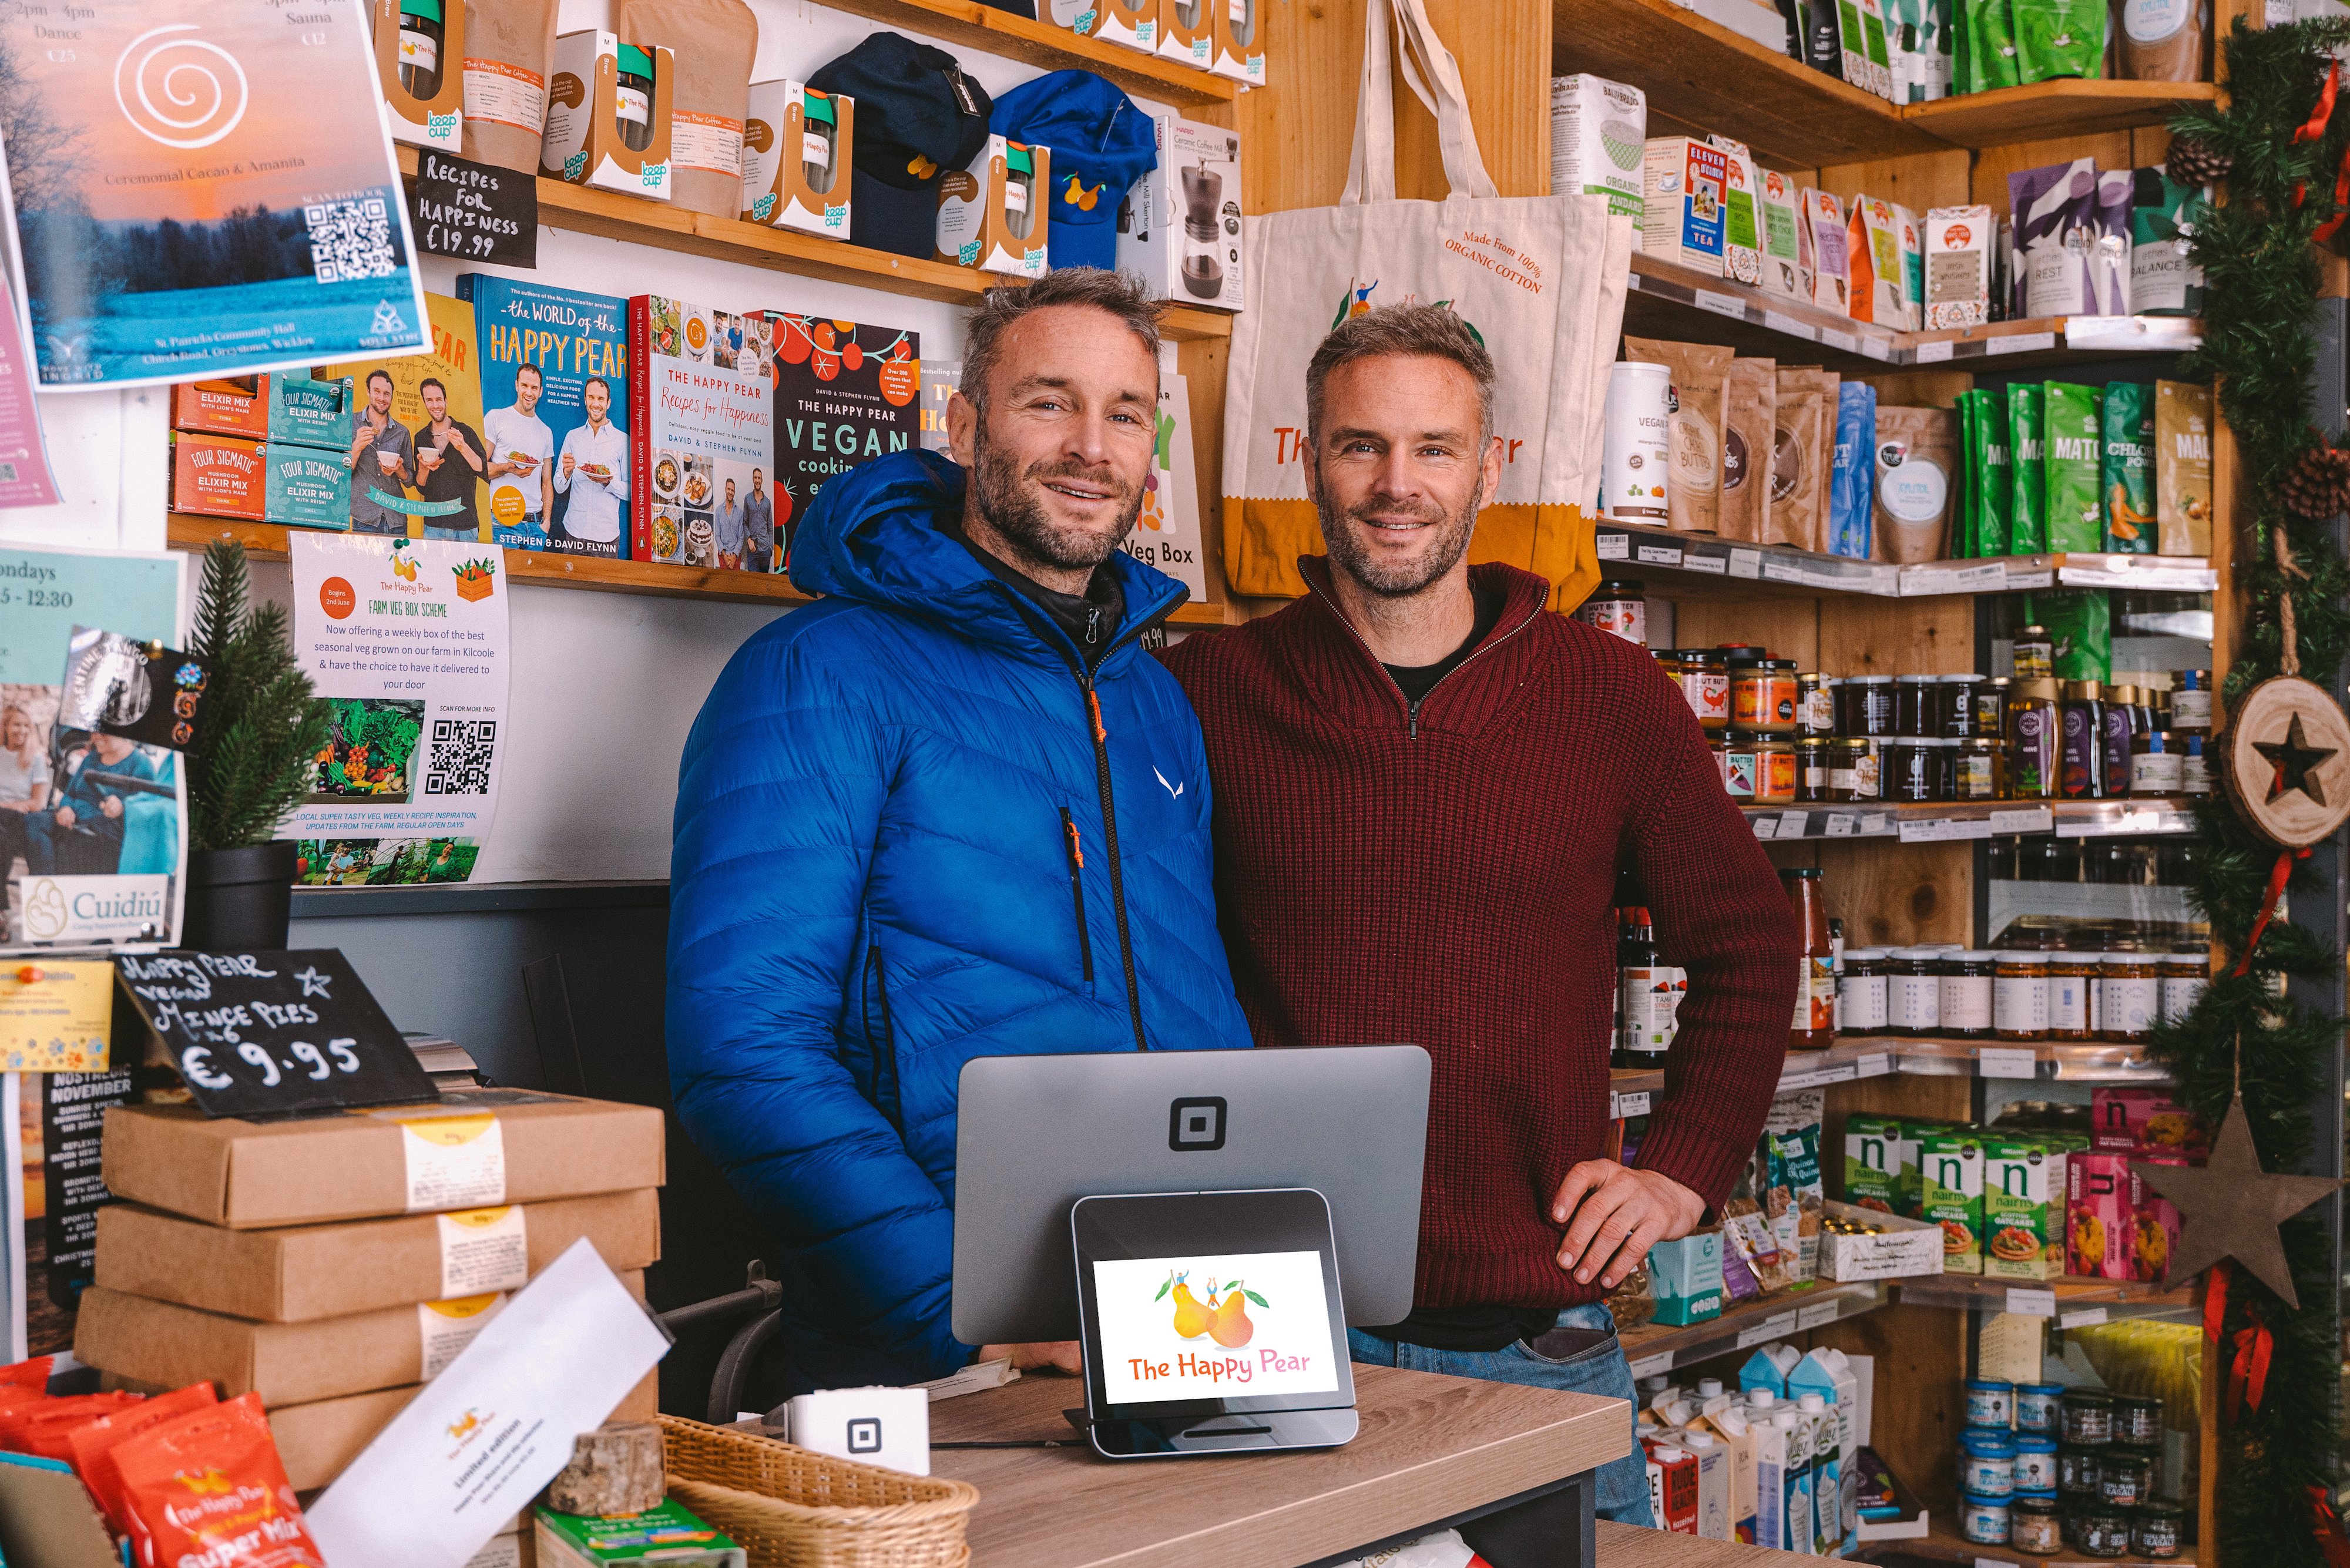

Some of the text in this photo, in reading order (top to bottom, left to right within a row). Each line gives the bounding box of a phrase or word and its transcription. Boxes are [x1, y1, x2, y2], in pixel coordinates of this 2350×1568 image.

[287, 13, 332, 25] Sauna
[35, 25, 82, 40] Dance
[418, 44, 427, 53] The
[479, 60, 499, 73] Happy
[501, 65, 511, 74] Pear
[1603, 87, 1639, 106] BALLYBRADO
[429, 112, 456, 130] keep
[1176, 126, 1194, 135] HARIO
[428, 126, 451, 140] cup
[1174, 135, 1196, 147] Ceramic
[1197, 140, 1213, 150] Coffee
[1690, 147, 1725, 167] ELEVEN
[105, 157, 305, 186] Ceremonial Cacao & Amanita
[427, 155, 499, 190] RECIPES
[643, 163, 666, 178] keep
[643, 175, 662, 189] cup
[1606, 176, 1640, 194] ORGANIC
[456, 188, 492, 211] FOR
[419, 197, 518, 235] HAPPINESS
[825, 204, 846, 220] keep
[825, 216, 842, 229] cup
[427, 224, 494, 257] €19.99
[1694, 233, 1713, 246] TEA
[1463, 231, 1542, 278] Made From 100%
[1445, 239, 1542, 294] ORGANIC COTTON
[2036, 266, 2062, 280] REST
[2132, 261, 2181, 278] BALANCE
[532, 303, 576, 325] WORLD
[578, 317, 592, 337] of
[491, 324, 629, 378] HAPPY PEAR
[669, 370, 761, 399] THE HAPPY PEAR
[662, 385, 768, 429] Recipes for Happiness
[798, 399, 895, 422] THE HAPPY PEAR
[669, 421, 689, 431] Delicious,
[1639, 417, 1664, 428] VEGAN
[669, 434, 691, 445] DAVID
[705, 441, 736, 452] STEPHEN
[740, 448, 762, 457] FLYNN
[786, 418, 908, 457] VEGAN
[1274, 427, 1304, 464] Th
[190, 449, 256, 475] FOUR SIGMATIC
[199, 477, 248, 490] ELIXIR MIX
[375, 492, 397, 508] DAVID
[407, 502, 435, 513] STEPHEN
[499, 535, 616, 553] STEPHEN & DAVID FLYNN
[1123, 539, 1193, 566] Veg Box
[381, 582, 433, 595] The Happy Pear
[28, 590, 72, 607] 12:30
[369, 600, 447, 617] FARM VEG BOX SCHEME
[326, 625, 345, 634] Now
[348, 626, 382, 637] offering
[392, 628, 421, 639] weekly
[424, 630, 438, 638] box
[441, 630, 449, 639] of
[451, 630, 465, 639] the
[468, 632, 484, 640] best
[73, 889, 162, 919] Cuidiú
[122, 953, 277, 999] HAPPY PEAR
[154, 1001, 318, 1042] MINCE PIES
[51, 1079, 132, 1104] NOVEMBER
[2003, 1163, 2027, 1196] n
[1995, 1217, 2036, 1227] OATCAKES
[1128, 1349, 1310, 1383] The Happy Pear
[1672, 1464, 1696, 1491] RUDE
